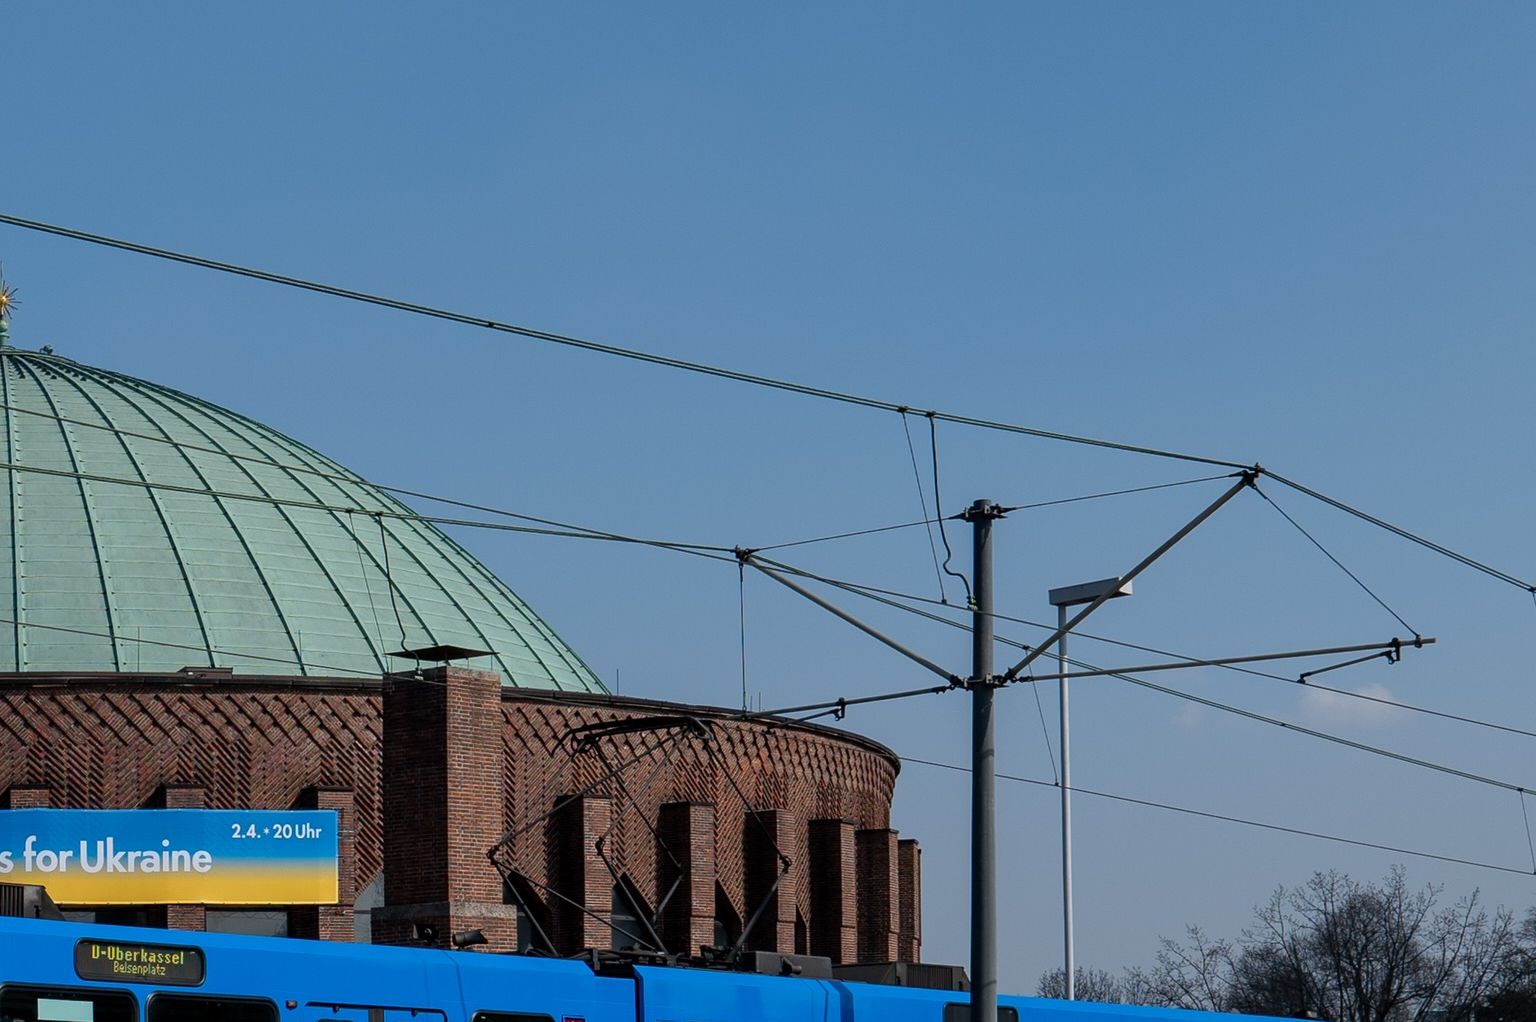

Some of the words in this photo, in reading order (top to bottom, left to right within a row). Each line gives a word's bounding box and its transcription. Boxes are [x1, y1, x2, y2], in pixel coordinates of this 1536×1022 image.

[231, 824, 261, 839] 2.4.
[273, 823, 292, 839] 20
[294, 823, 322, 839] Uhr
[23, 835, 74, 873] for
[80, 836, 213, 873] Ukraine
[90, 944, 184, 965] D-Oberkassel
[113, 960, 166, 976] Belsenplatz
